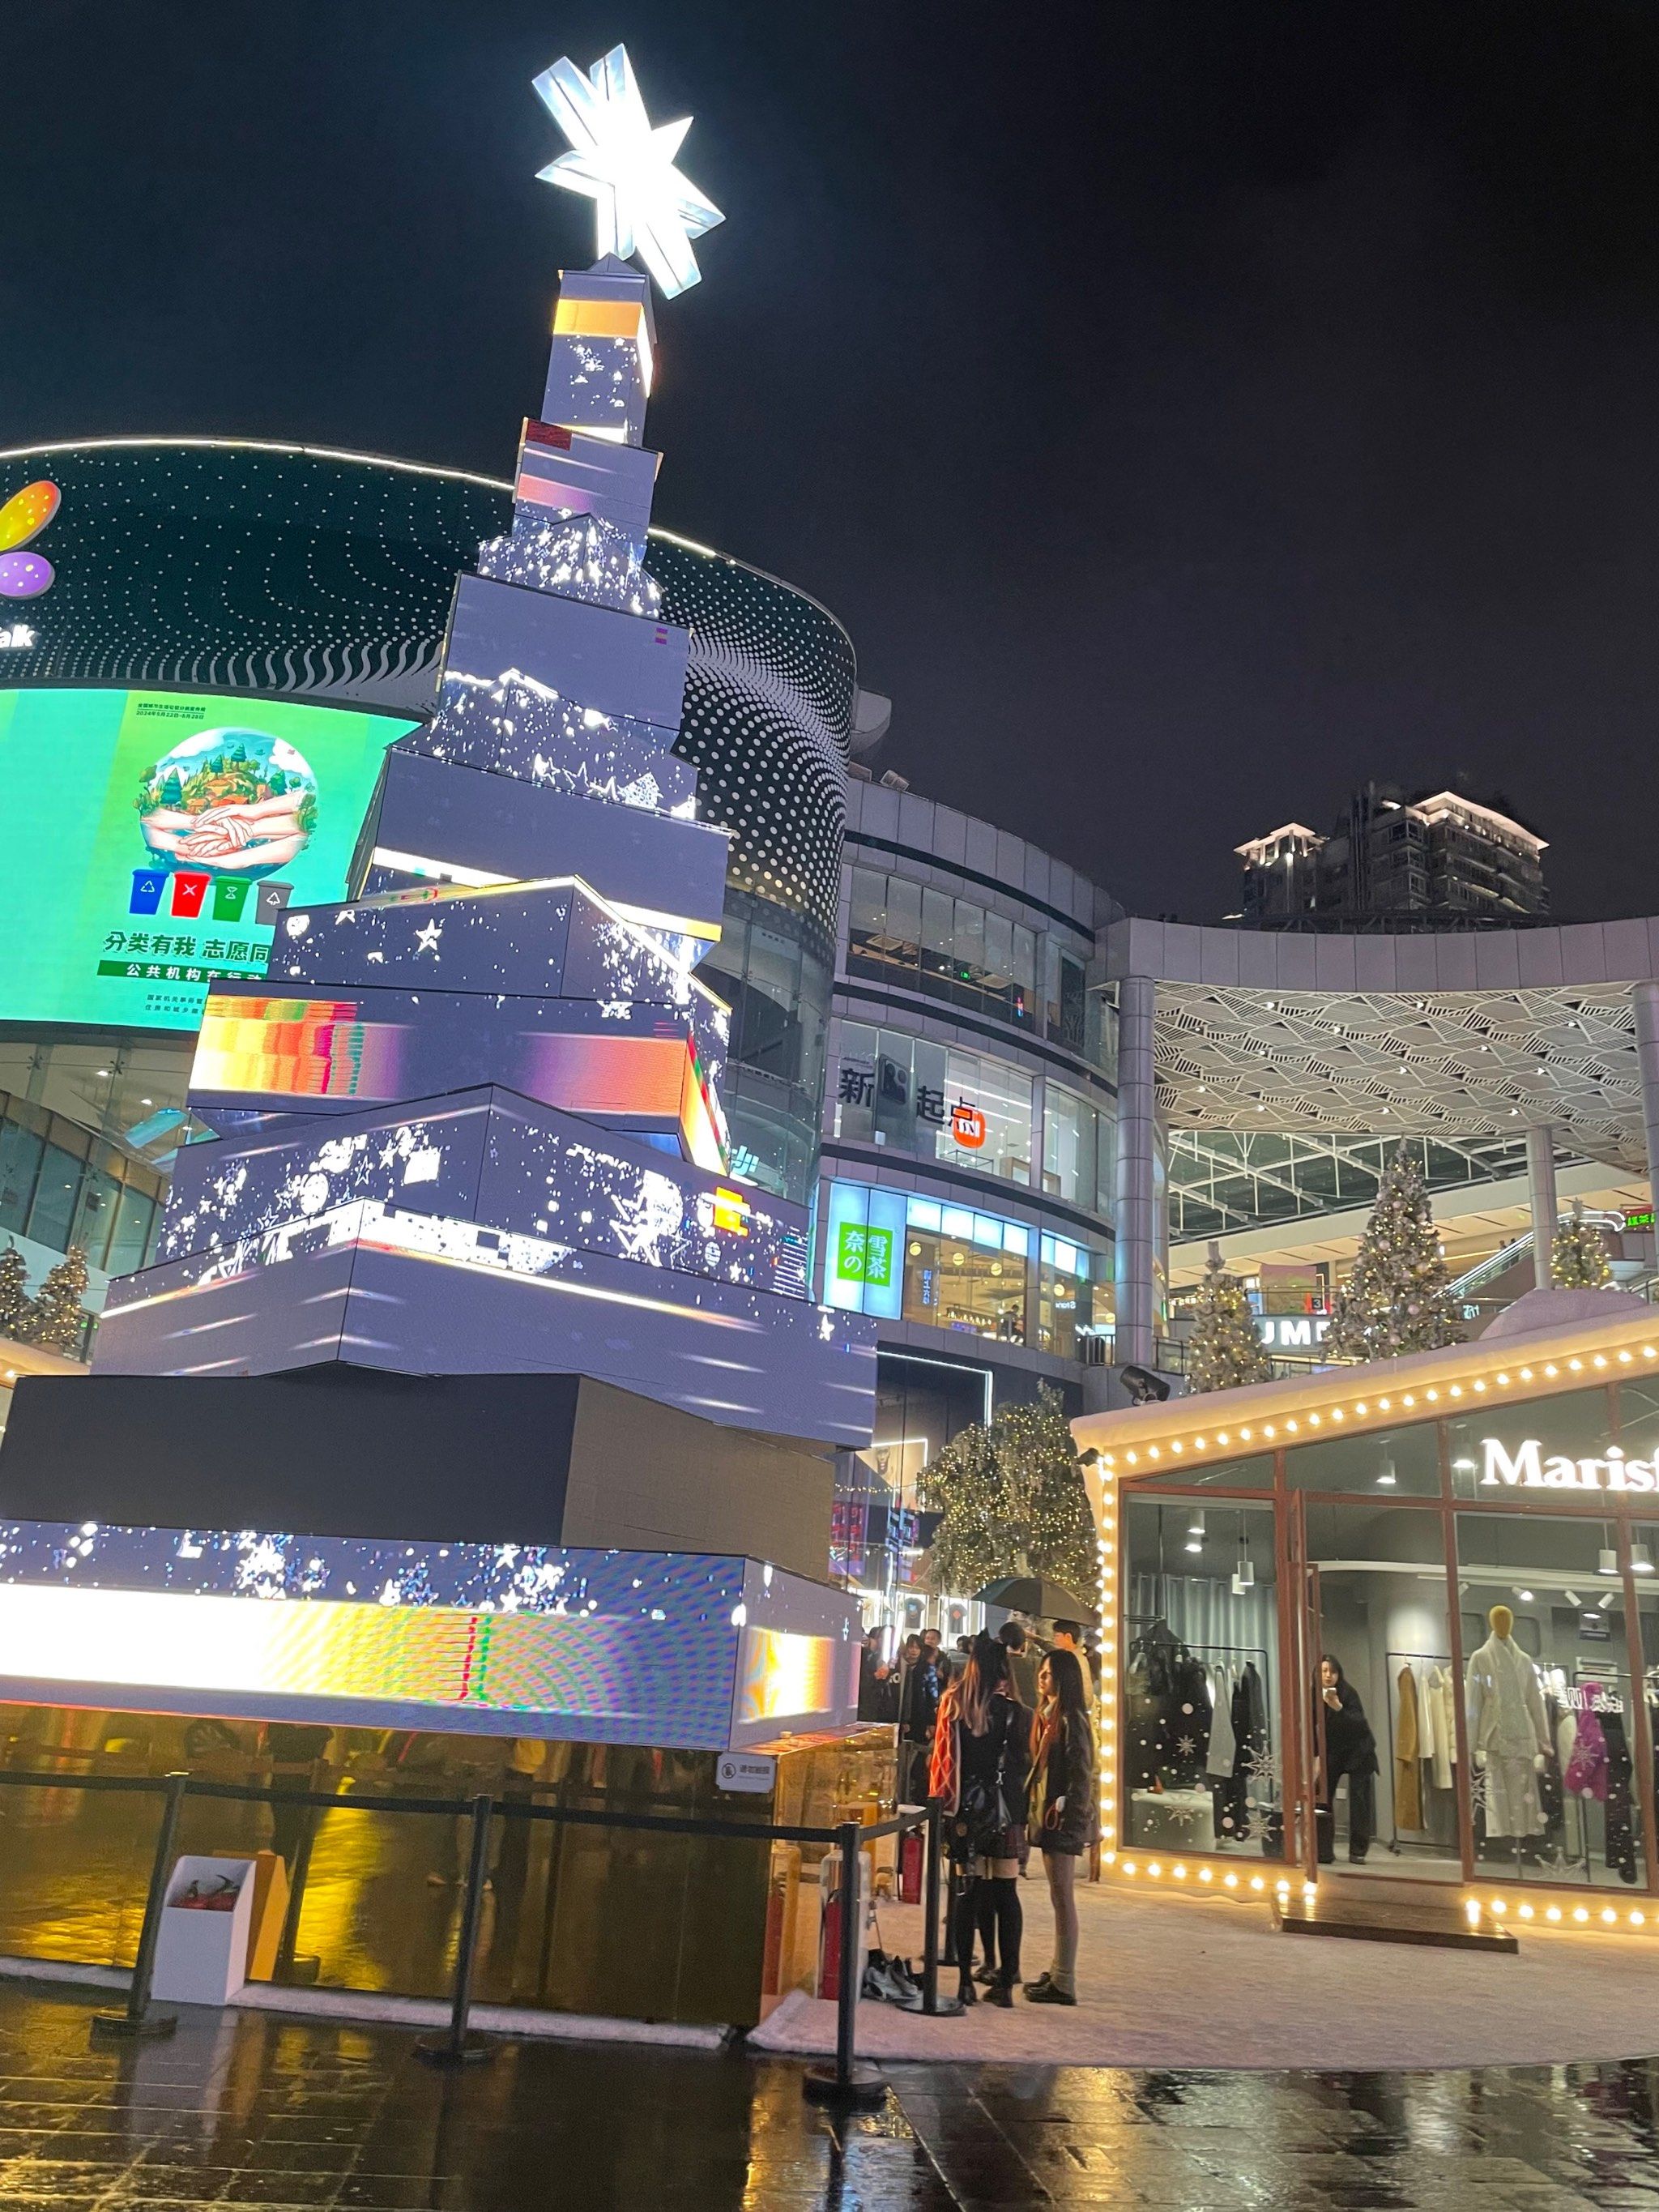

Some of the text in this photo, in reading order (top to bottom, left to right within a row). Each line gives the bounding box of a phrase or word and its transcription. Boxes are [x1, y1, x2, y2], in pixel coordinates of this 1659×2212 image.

[0, 624, 36, 647] alk
[104, 931, 196, 956] 分类有我
[845, 1230, 888, 1257] 奈雪
[843, 1255, 888, 1279] の茶
